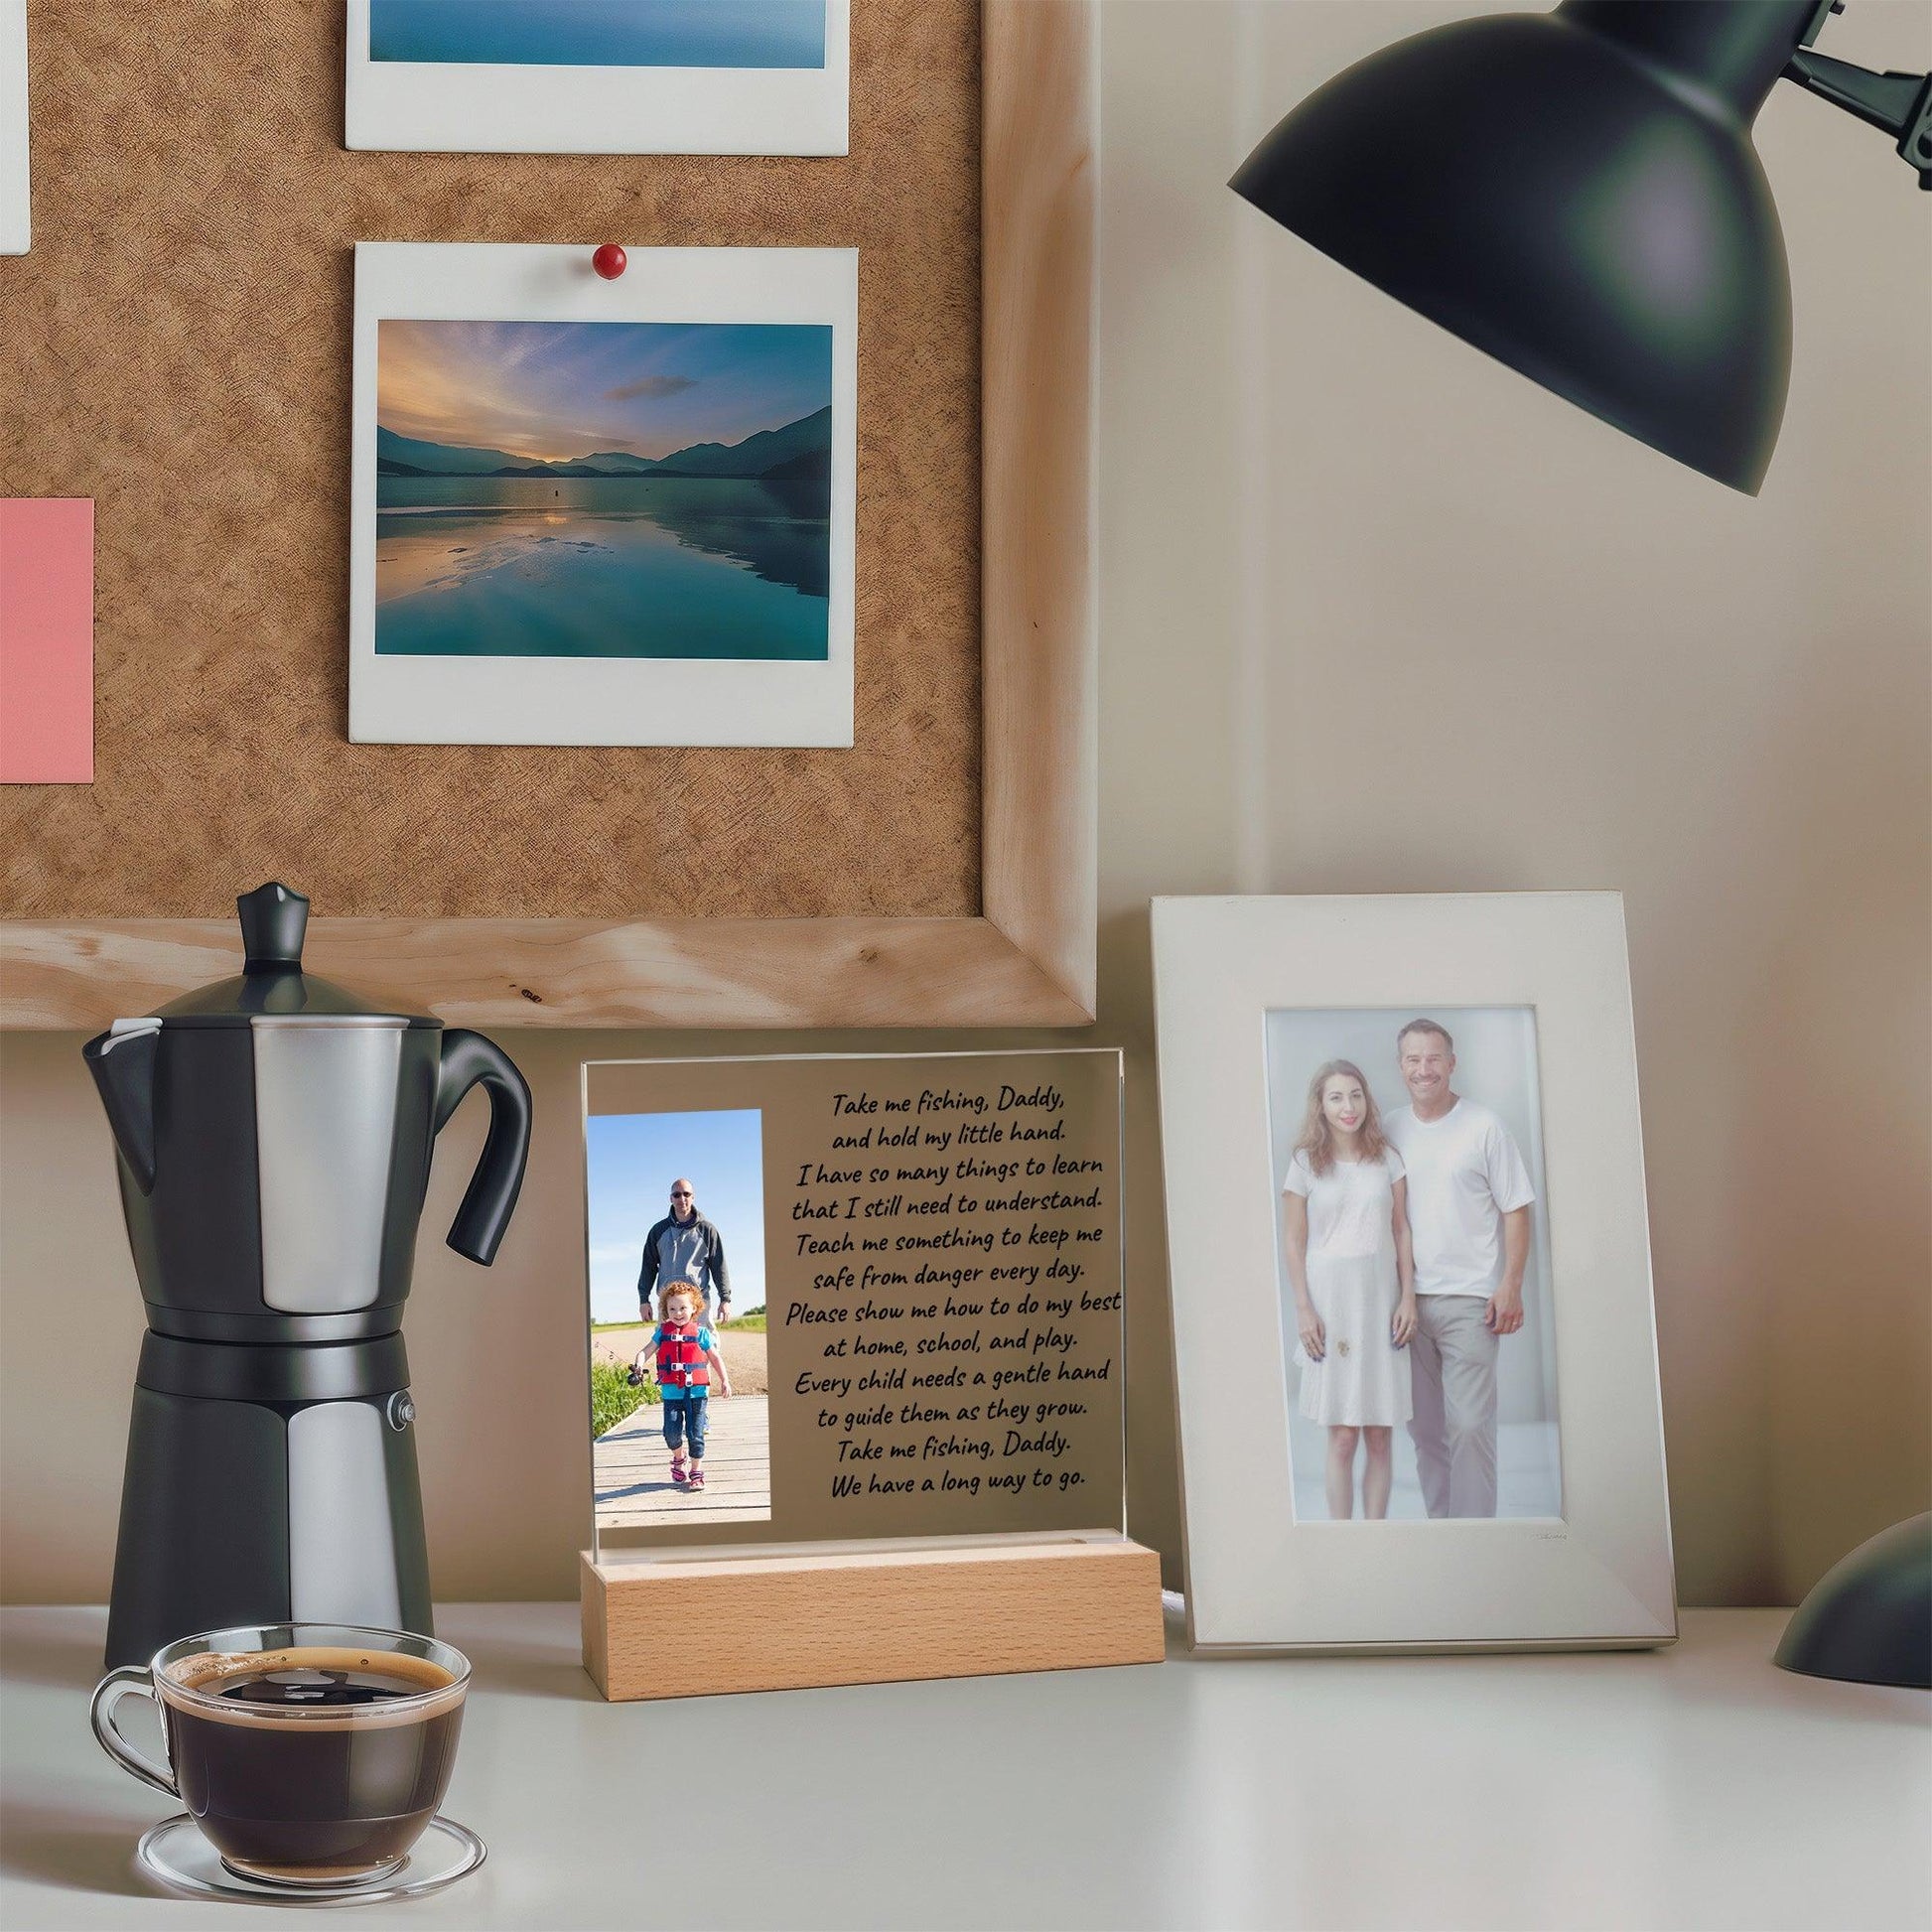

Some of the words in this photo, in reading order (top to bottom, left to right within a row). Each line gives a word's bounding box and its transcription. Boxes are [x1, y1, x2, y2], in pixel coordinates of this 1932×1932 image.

[834, 1092, 878, 1116] Take
[886, 1099, 910, 1112] me
[917, 1089, 988, 1115] fishing,
[997, 1086, 1063, 1112] Daddy,
[832, 1128, 872, 1149] and
[878, 1126, 920, 1147] hold
[925, 1132, 952, 1152] my
[958, 1122, 1003, 1144] little
[1010, 1120, 1065, 1141] hand.
[796, 1165, 813, 1186] I
[816, 1164, 862, 1183] have
[870, 1169, 890, 1182] so
[897, 1167, 949, 1185] many
[956, 1158, 1019, 1182] things
[1027, 1158, 1045, 1175] to
[1052, 1154, 1102, 1174] learn
[793, 1199, 838, 1220] that
[844, 1196, 861, 1219] I
[865, 1195, 902, 1217] still
[906, 1193, 953, 1214] need
[958, 1195, 977, 1213] to
[985, 1187, 1102, 1212] understand.
[797, 1232, 854, 1256] Teach
[863, 1238, 888, 1251] me
[896, 1227, 994, 1252] something
[1002, 1228, 1022, 1246] to
[1029, 1223, 1069, 1250] keep
[1076, 1229, 1103, 1241] me
[813, 1266, 855, 1291] safe
[862, 1265, 907, 1290] from
[914, 1264, 984, 1289] danger
[990, 1266, 1039, 1285] every
[1046, 1258, 1084, 1284] day.
[786, 1303, 848, 1325] Please
[855, 1300, 904, 1321] show
[911, 1305, 937, 1317] me
[944, 1297, 984, 1315] how
[991, 1298, 1010, 1315] to
[1018, 1293, 1038, 1314] do
[1046, 1300, 1072, 1318] my
[1080, 1291, 1121, 1311] best
[824, 1339, 847, 1357] at
[854, 1335, 907, 1356] home,
[917, 1330, 980, 1353] school,
[990, 1328, 1030, 1349] and
[1033, 1326, 1077, 1355] play.
[795, 1372, 851, 1398] Every
[859, 1368, 906, 1391] child
[912, 1366, 966, 1387] needs
[973, 1372, 986, 1385] a
[993, 1361, 1050, 1390] gentle
[1057, 1359, 1110, 1380] hand
[818, 1409, 838, 1427] to
[845, 1404, 894, 1432] guide
[900, 1402, 950, 1423] them
[956, 1406, 980, 1420] as
[988, 1398, 1030, 1424] they
[1035, 1404, 1087, 1423] grow.
[838, 1439, 883, 1462] Take
[891, 1445, 916, 1457] me
[923, 1435, 994, 1460] fishing,
[1003, 1431, 1070, 1457] Daddy.
[832, 1475, 861, 1497] We
[869, 1473, 914, 1493] have
[921, 1479, 934, 1491] a
[941, 1469, 980, 1495] long
[989, 1475, 1026, 1494] way
[1033, 1468, 1052, 1486] to
[1059, 1472, 1085, 1491] go.
